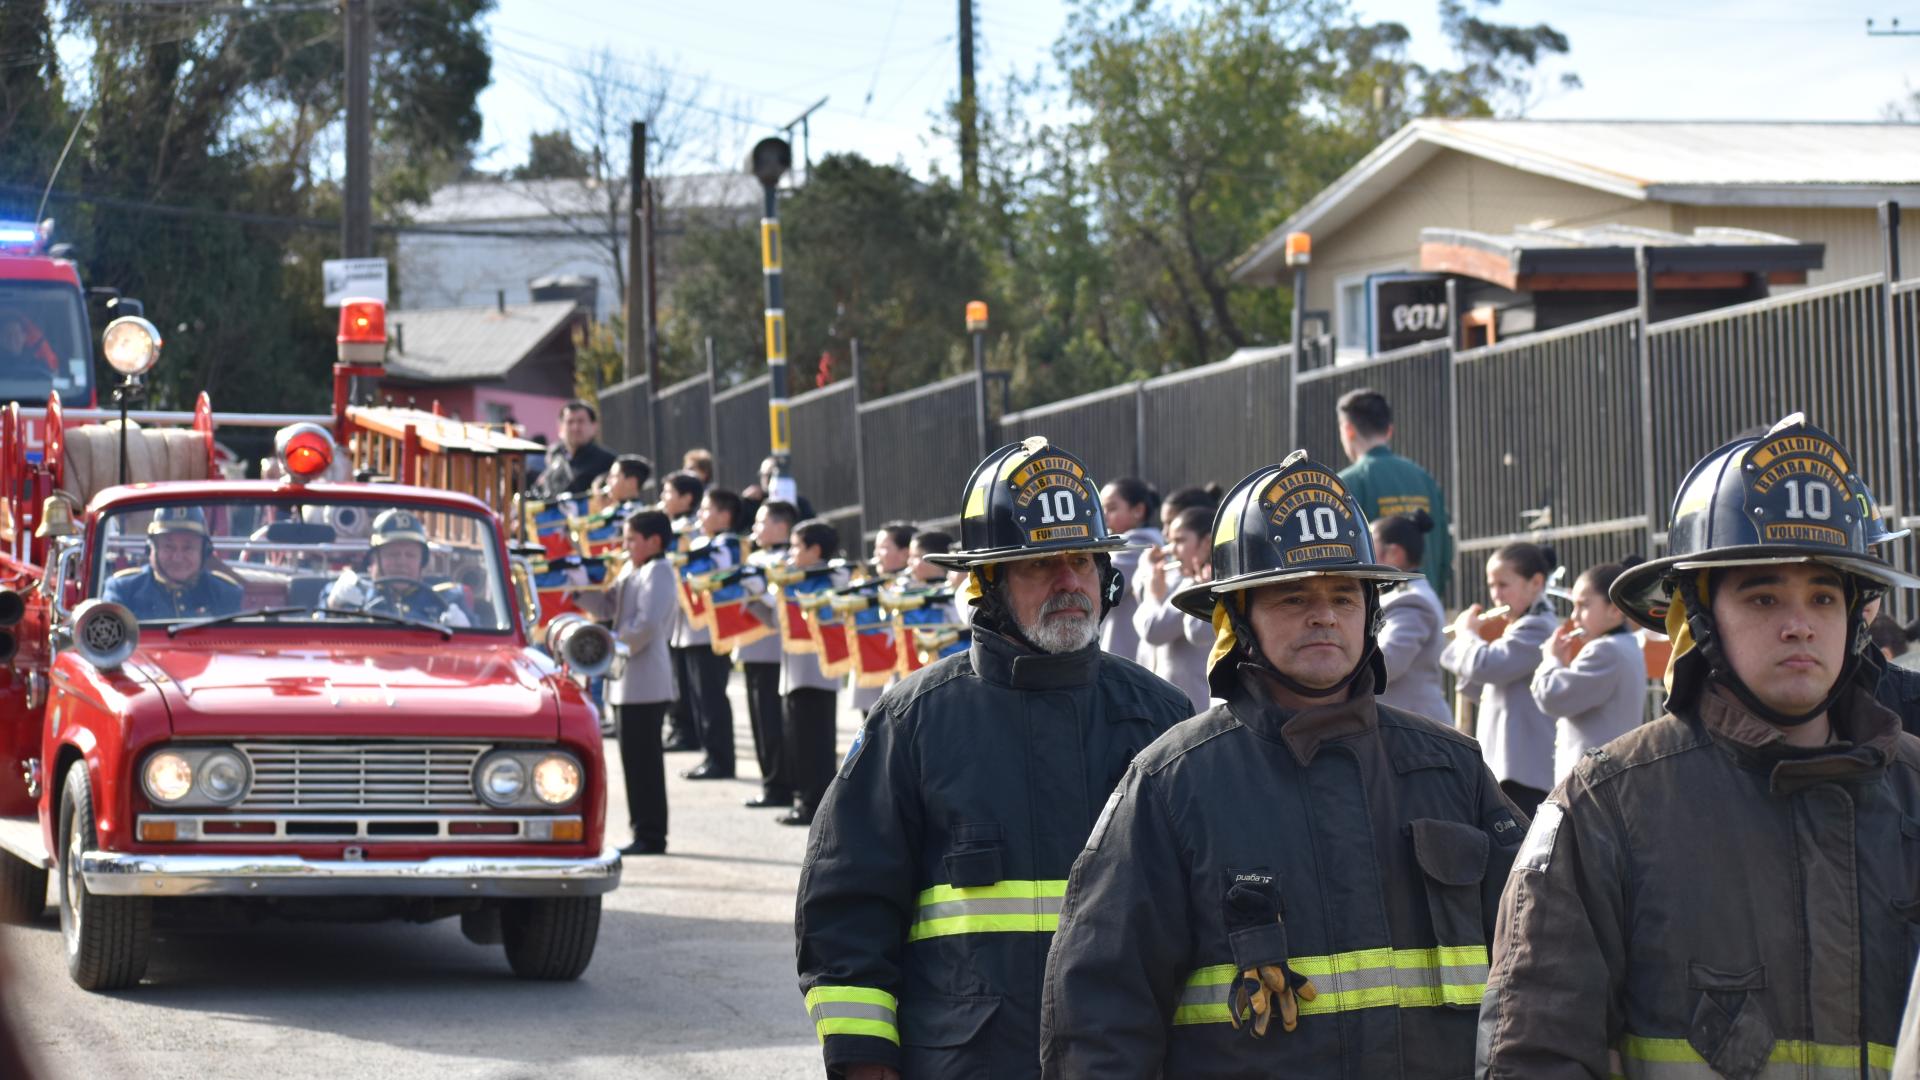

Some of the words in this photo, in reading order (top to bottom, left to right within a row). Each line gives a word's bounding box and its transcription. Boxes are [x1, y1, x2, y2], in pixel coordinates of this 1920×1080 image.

[1766, 438, 1834, 460] VALDIVIA
[1024, 458, 1074, 476] VALDIVIA
[1757, 460, 1805, 490] BOMBA
[1018, 476, 1052, 504] BOMBA
[1055, 475, 1085, 498] NIEBLA
[1278, 472, 1332, 490] VALDIVIA
[1037, 490, 1076, 524] 10
[1272, 492, 1311, 523] BOMBA
[1784, 479, 1832, 520] 10
[1036, 526, 1083, 540] FUNDADOR
[1295, 507, 1338, 542] 10
[1769, 525, 1844, 544] VOLUNTARIO
[1289, 545, 1352, 561] VOLUNTARIO
